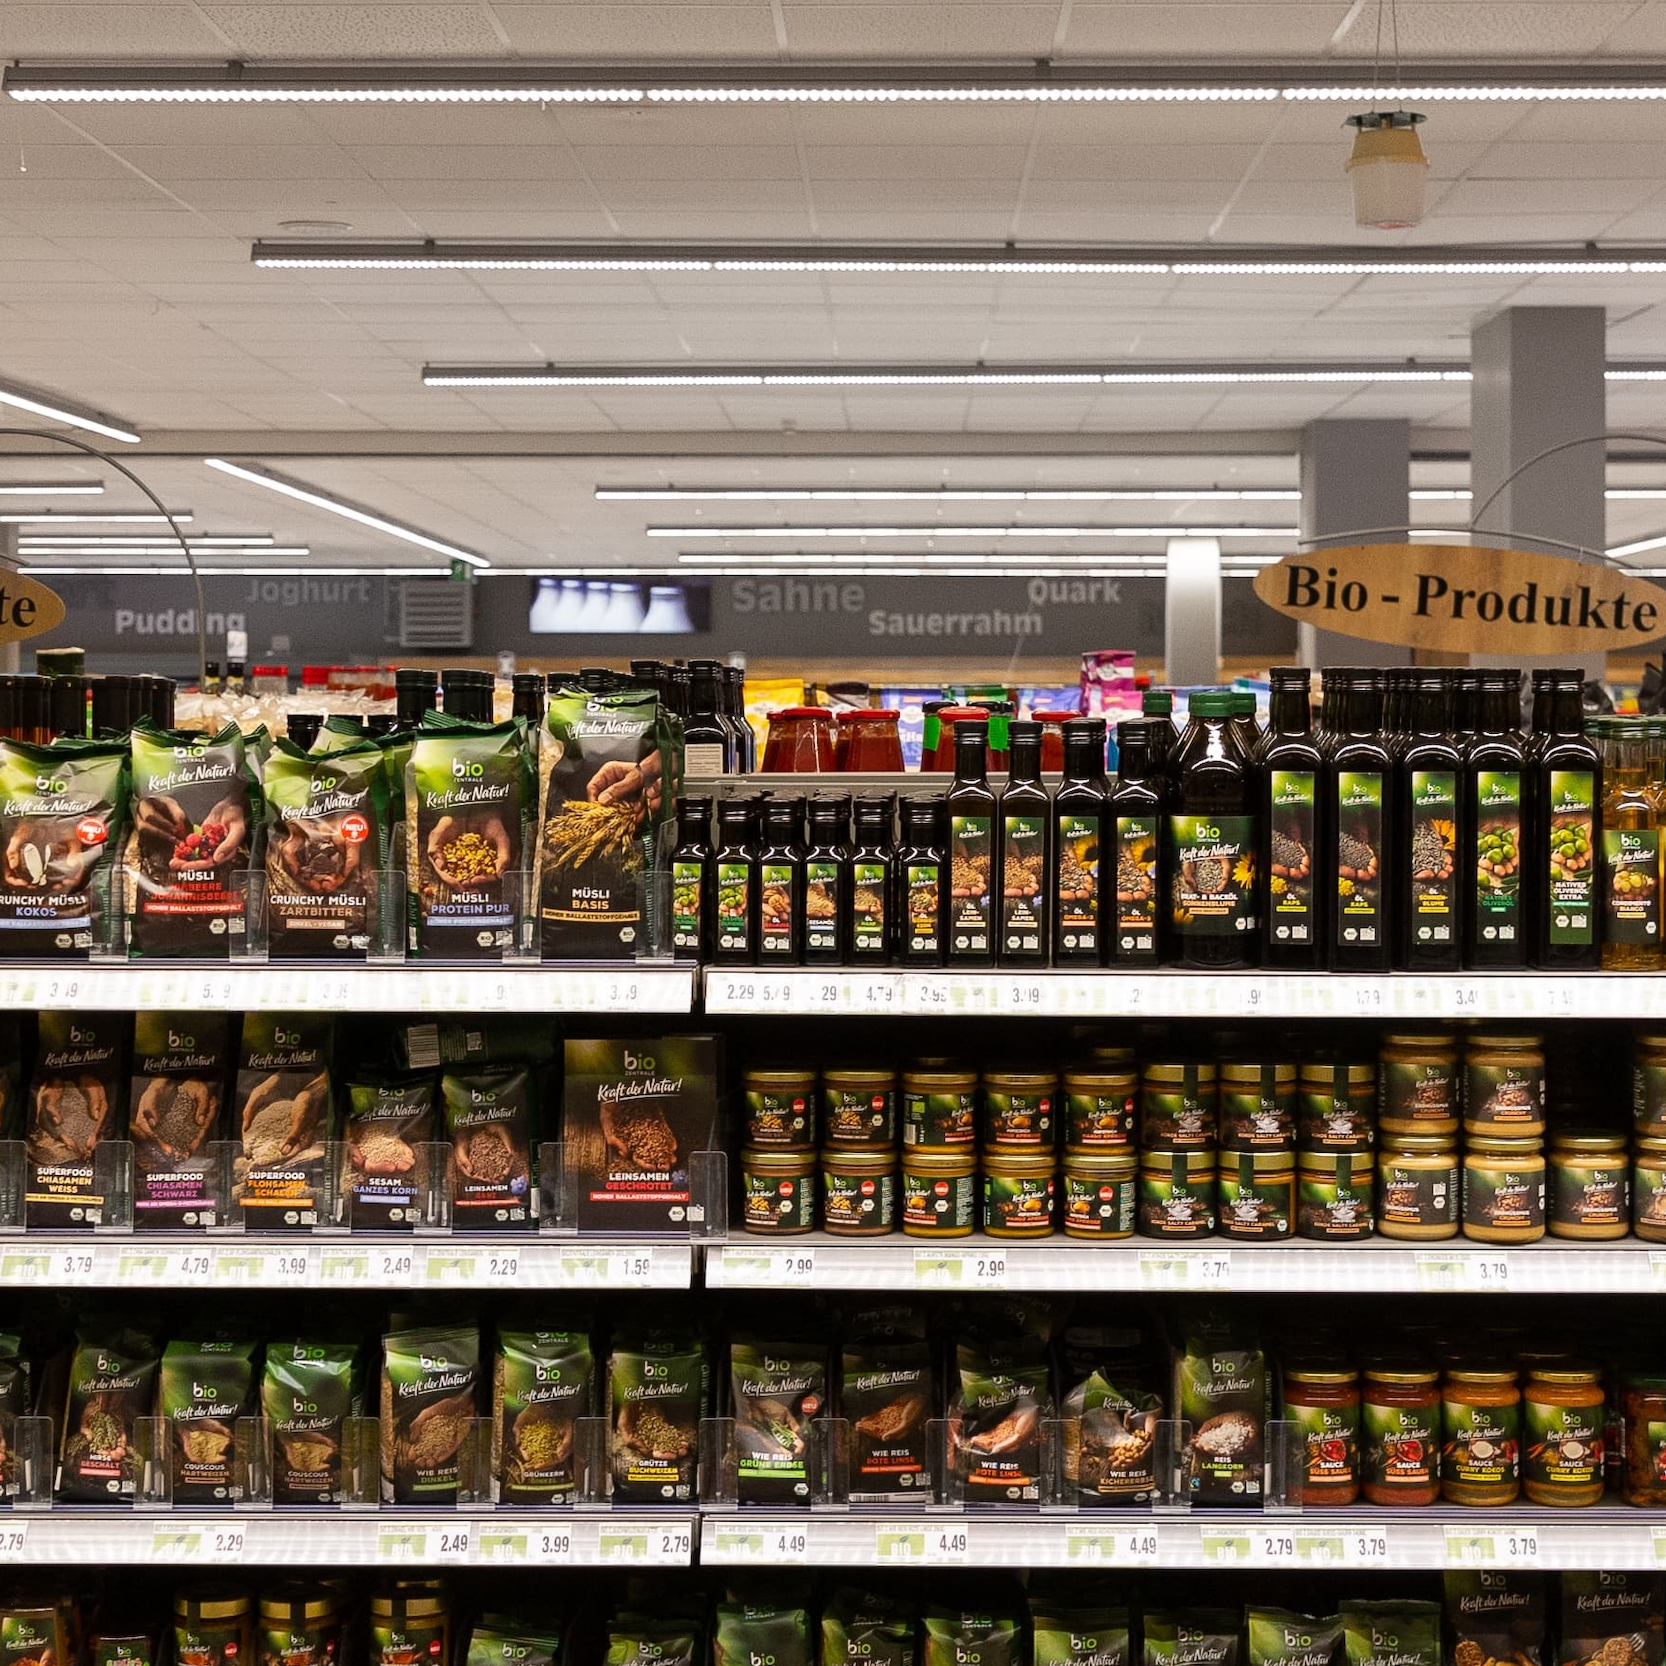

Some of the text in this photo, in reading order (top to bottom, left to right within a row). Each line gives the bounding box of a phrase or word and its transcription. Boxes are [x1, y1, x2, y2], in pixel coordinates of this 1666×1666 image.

[732, 578, 864, 613] Sahne
[1028, 577, 1120, 604] Quark
[1284, 566, 1366, 613] Bio
[1414, 574, 1657, 633] Produkte
[869, 610, 1042, 636] Sauerrahm
[451, 759, 484, 776] bio
[1195, 822, 1220, 838] bio
[451, 892, 488, 903] MÜSLI
[572, 888, 610, 899] MÜSLI
[44, 894, 87, 906] MÜSLI
[269, 895, 365, 906] CRUNCHY MÜSLI
[572, 900, 608, 910] BASIS
[15, 907, 57, 917] KOKOS
[279, 907, 353, 917] ZARTBITTER
[431, 903, 510, 914] PROTEIN PUR
[624, 1050, 656, 1069] bio
[37, 1168, 93, 1178] SUPERFOOD
[610, 1172, 669, 1182] LEINSAMEN
[37, 1176, 92, 1185] CHIASAMEN
[605, 1182, 674, 1191] GESCHROTET
[48, 1185, 80, 1193] WEISS
[64, 1255, 92, 1273] 3.79
[383, 1255, 411, 1273] 2.49
[977, 1260, 1005, 1277] 2.99
[752, 1452, 792, 1461] WIE REIS
[542, 1536, 569, 1554] 3.99
[662, 1536, 689, 1554] 2.79
[1509, 1539, 1537, 1556] 3.79
